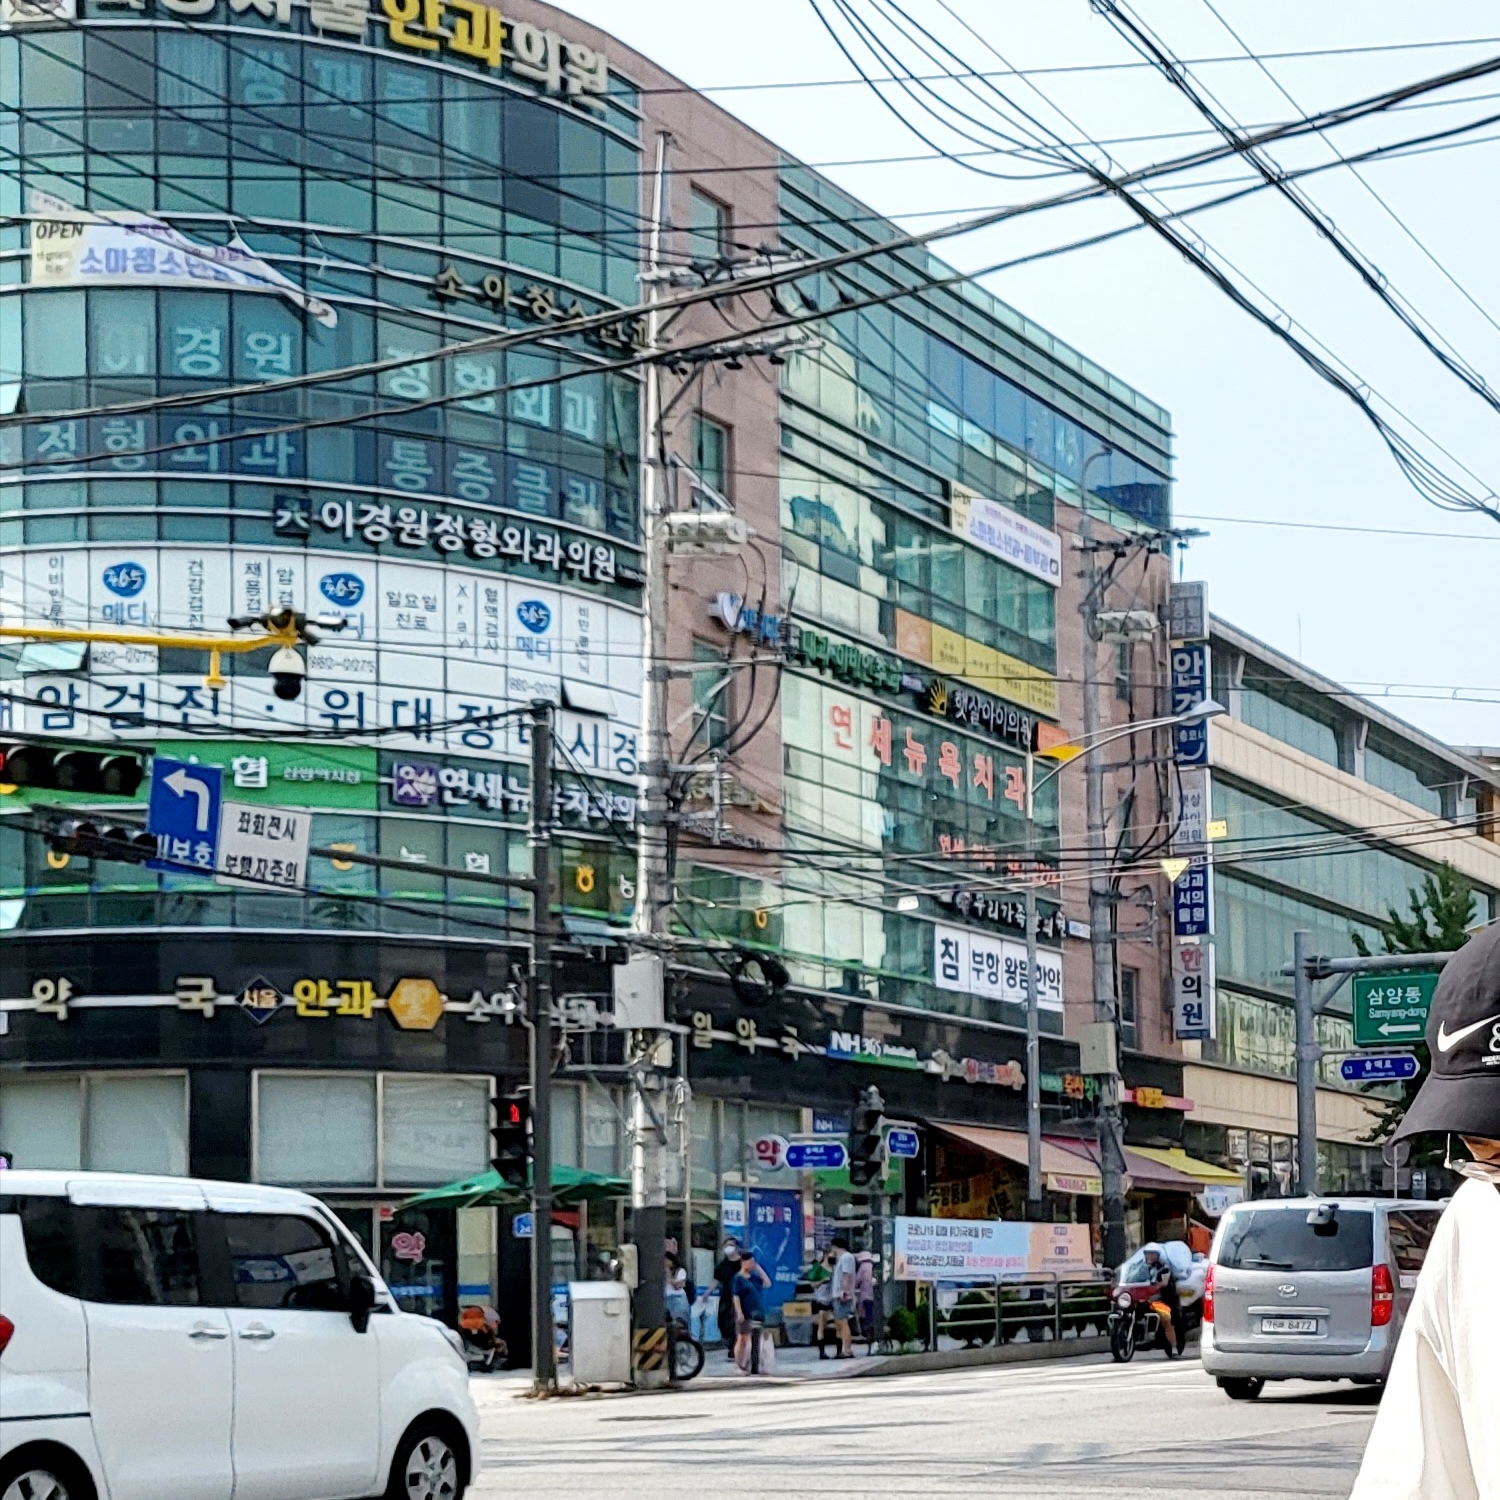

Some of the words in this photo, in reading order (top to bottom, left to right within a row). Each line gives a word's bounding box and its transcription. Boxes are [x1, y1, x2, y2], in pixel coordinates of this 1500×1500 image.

[36, 222, 84, 240] OPEN
[321, 499, 616, 584] 이경원정형외과의원
[955, 689, 1033, 746] 햇살아이의원
[830, 704, 1026, 811] 연세뉴욕치과
[940, 937, 960, 982] 침
[972, 950, 1000, 985] 부항
[293, 978, 376, 1019] 안과
[1181, 948, 1204, 1027] 한의원
[1367, 986, 1422, 1006] 삼양동
[1368, 1006, 1428, 1019] Samyang-dong
[832, 1030, 861, 1053] NH
[756, 1140, 781, 1166] 약
[392, 1231, 426, 1263] 약
